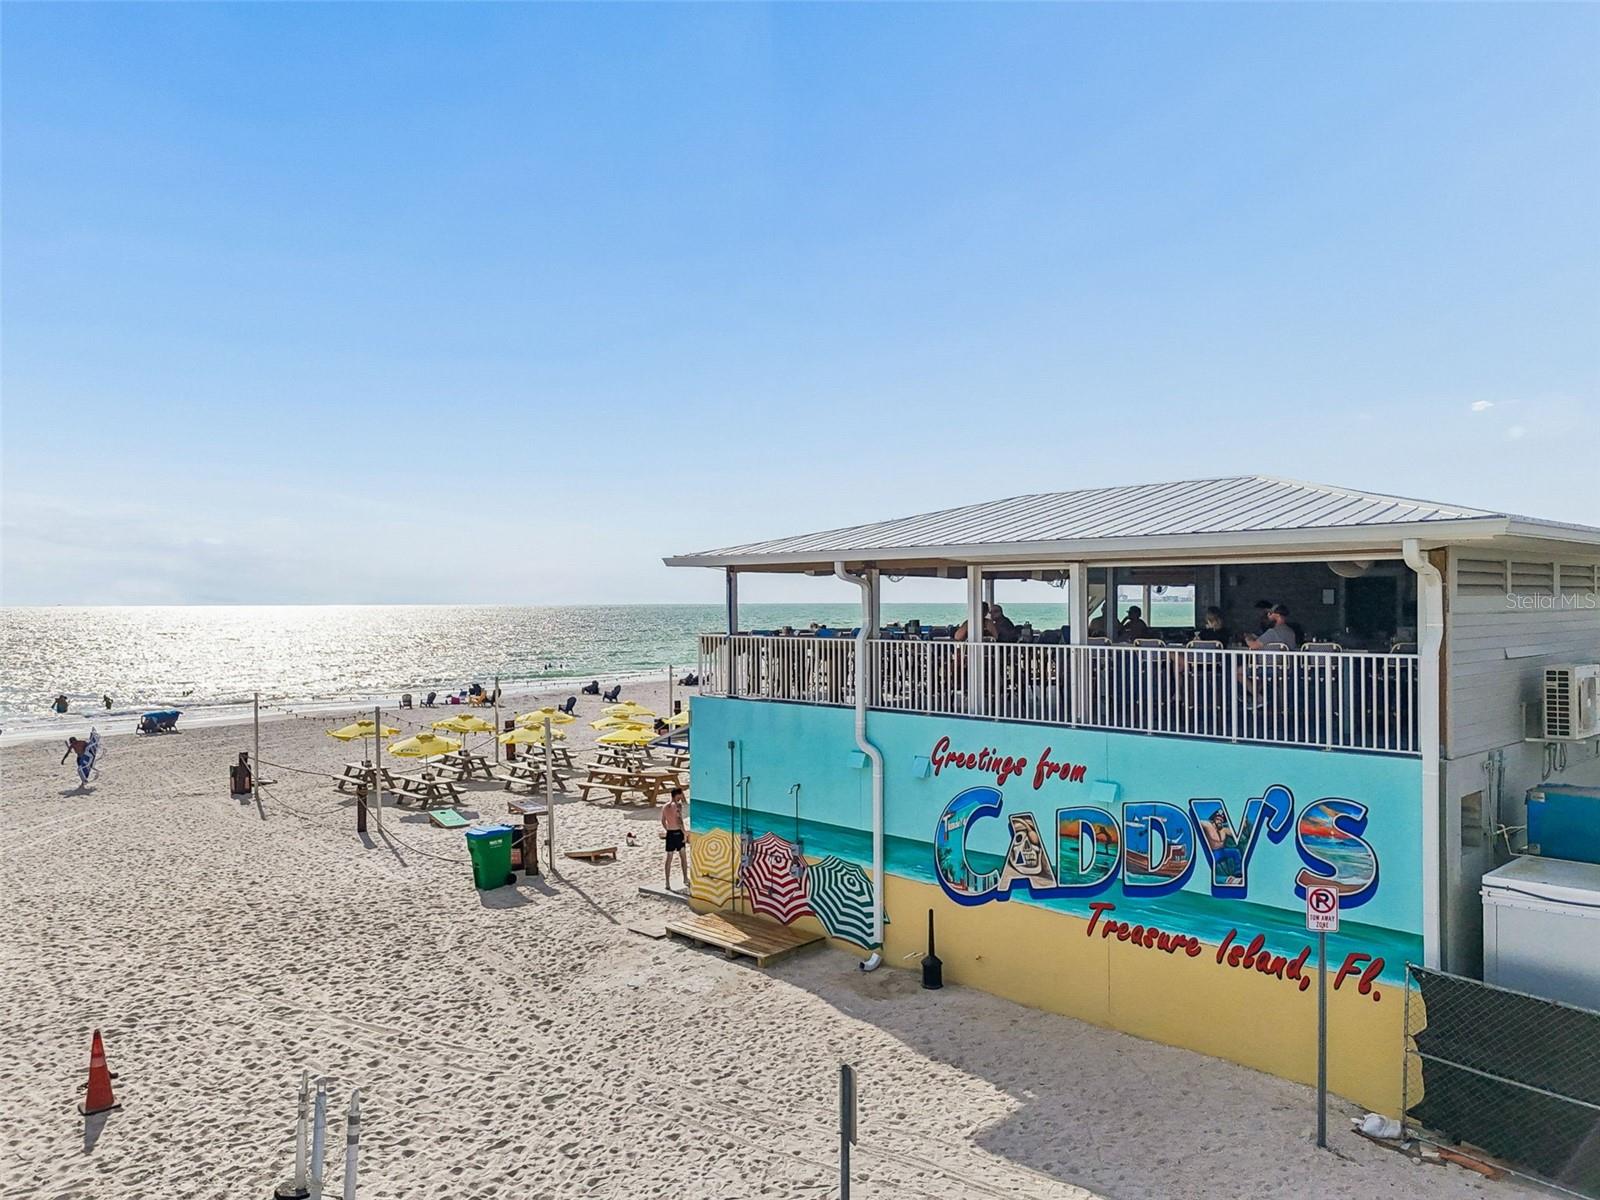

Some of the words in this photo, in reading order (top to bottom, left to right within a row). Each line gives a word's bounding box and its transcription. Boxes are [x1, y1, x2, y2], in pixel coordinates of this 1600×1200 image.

[931, 736, 1028, 787] Greetings
[1033, 747, 1088, 791] from
[934, 784, 1380, 909] CADDY'S
[1086, 902, 1202, 957] Treasure
[1216, 928, 1312, 992] Island,
[1333, 953, 1386, 1002] Fl.
